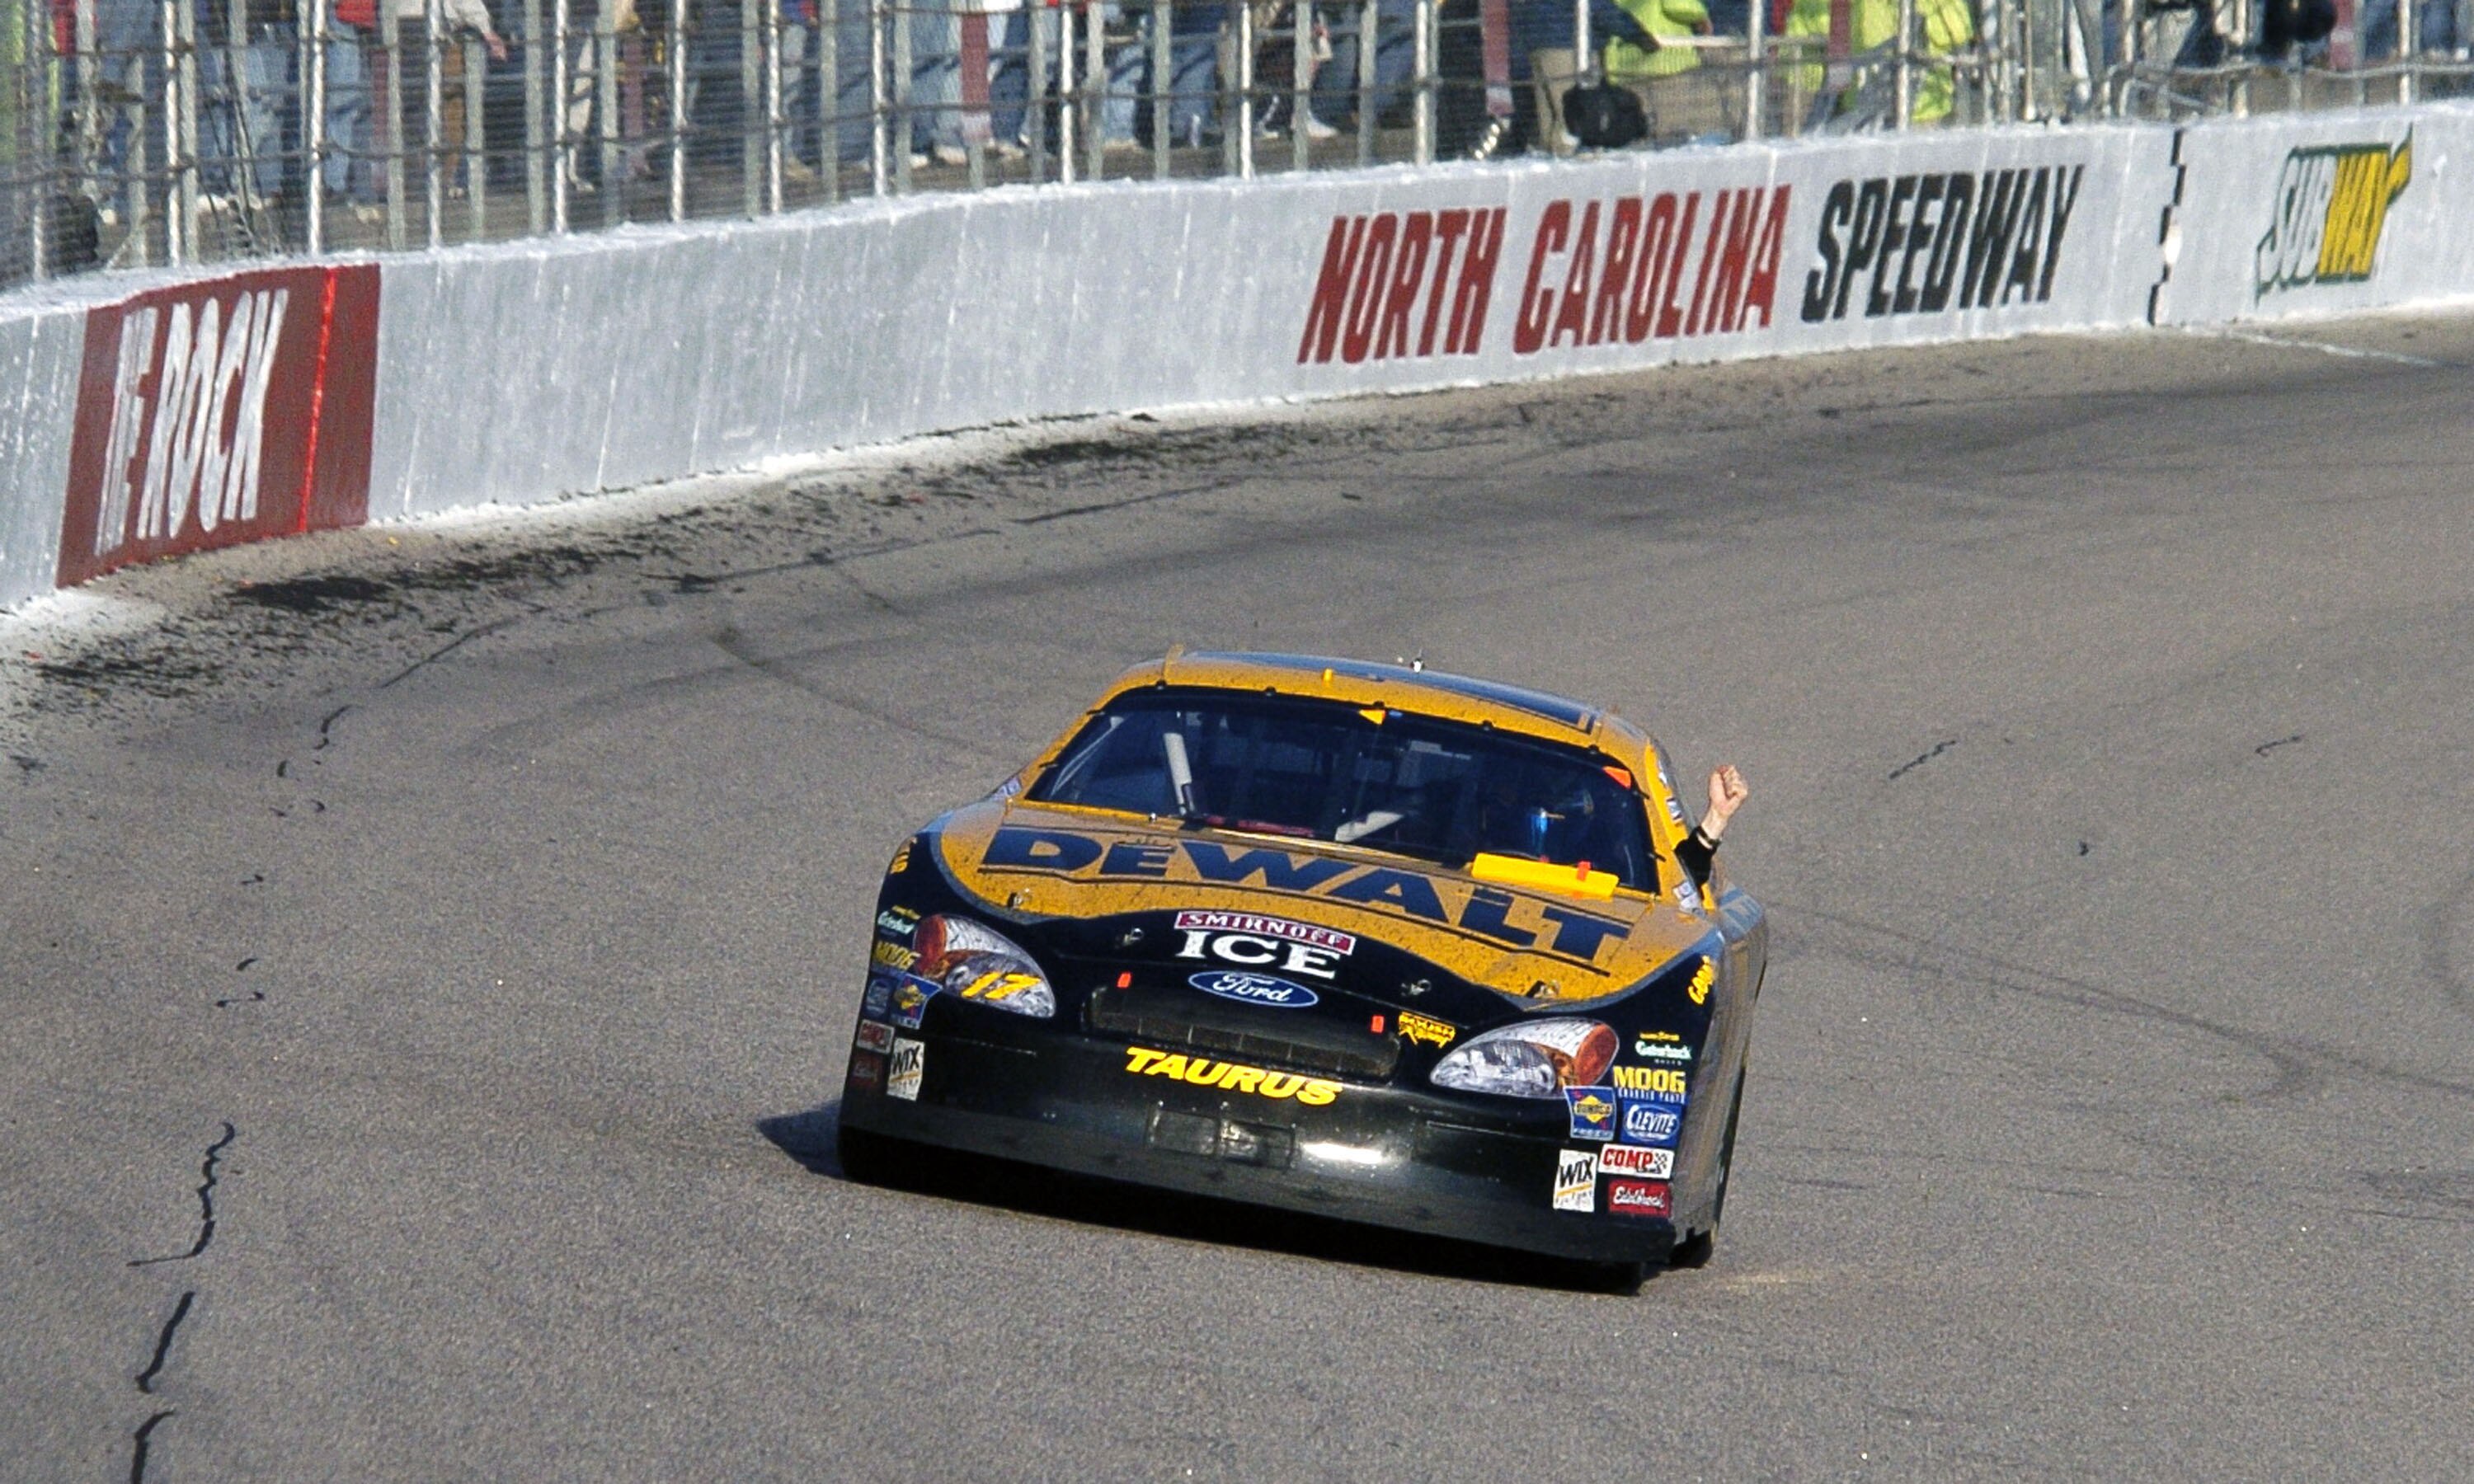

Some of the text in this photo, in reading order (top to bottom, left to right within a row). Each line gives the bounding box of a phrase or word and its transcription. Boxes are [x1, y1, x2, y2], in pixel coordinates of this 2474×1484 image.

[1297, 165, 2086, 364] NORTH CAROLINA SPEEDWAY
[136, 289, 289, 540] ROCK
[981, 828, 1630, 960] DEWALT
[1184, 910, 1344, 946] SMIRNOFF
[1176, 929, 1341, 979] ICE
[962, 971, 1042, 1000] 17
[1212, 973, 1293, 1003] Ford
[891, 1044, 920, 1075] WIX
[1126, 1046, 1343, 1106] TAURUS
[1613, 1064, 1686, 1094] MOOG
[1626, 1105, 1677, 1134] CLEVITE
[1558, 1156, 1594, 1189] WIX
[1603, 1148, 1653, 1169] COMP
